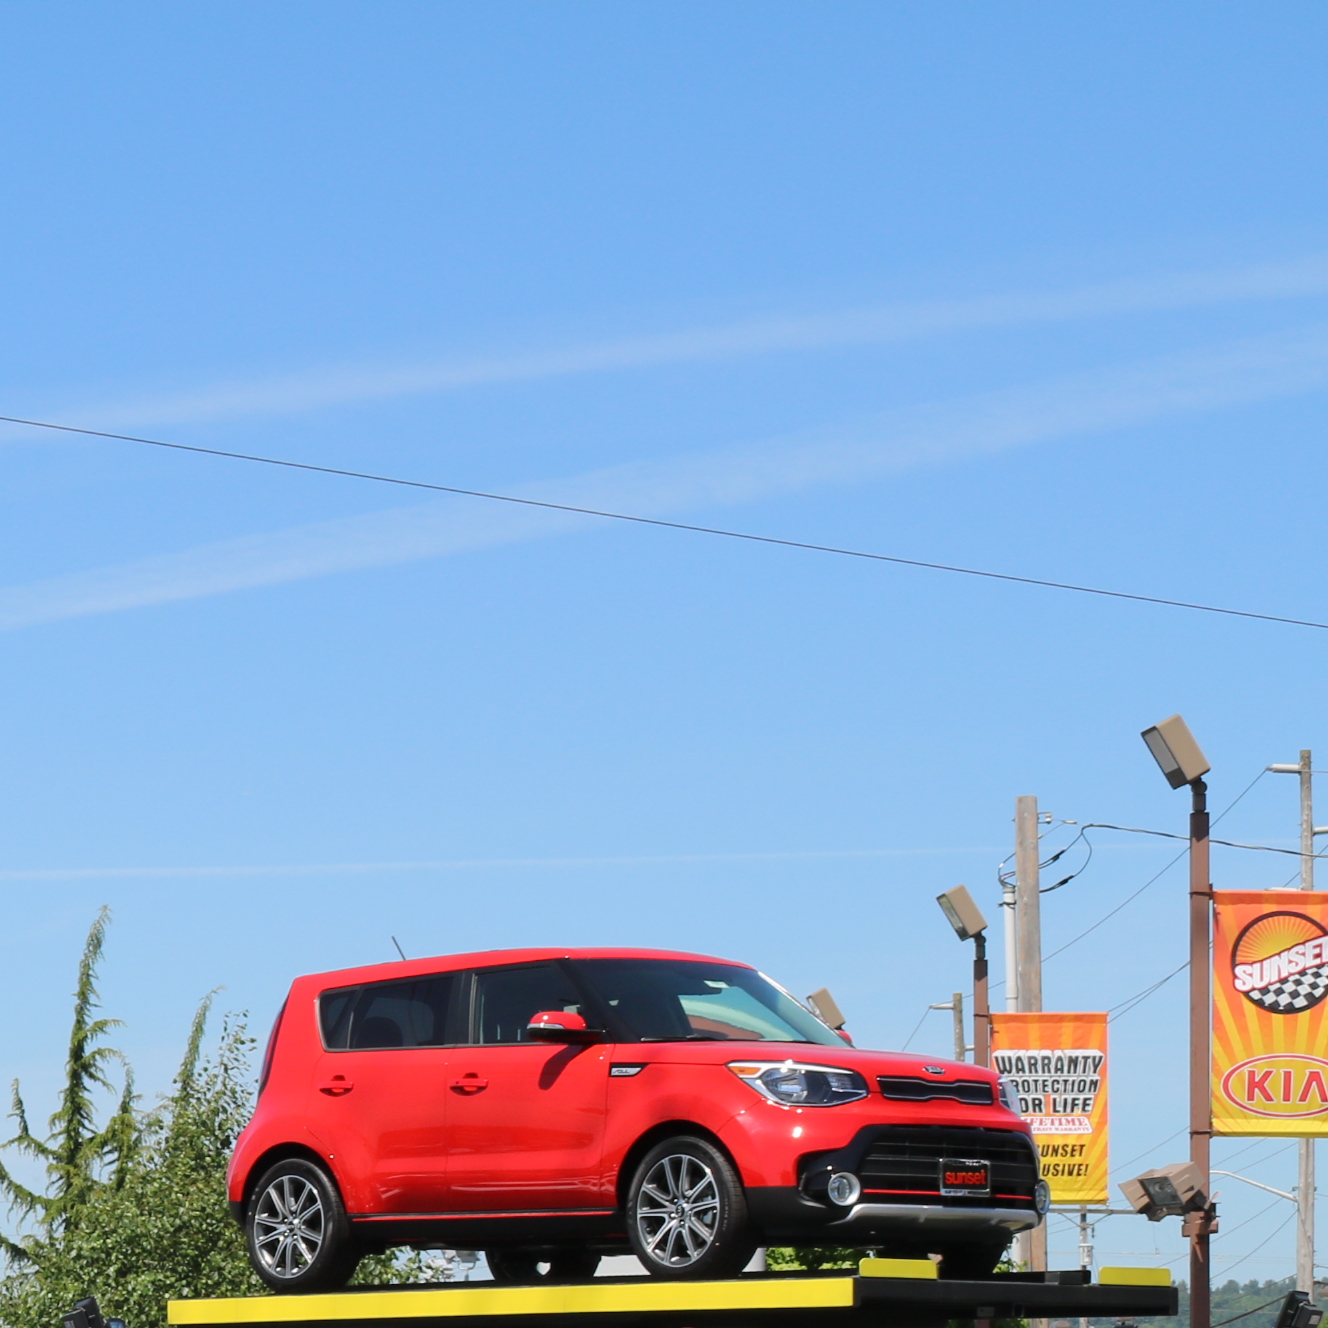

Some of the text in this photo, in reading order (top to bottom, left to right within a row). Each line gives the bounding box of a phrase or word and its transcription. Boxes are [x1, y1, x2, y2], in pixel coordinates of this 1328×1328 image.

[994, 1054, 1105, 1075] WARRANTY
[1010, 1079, 1099, 1094] ROTECTION
[1246, 1068, 1328, 1103] KIA
[1019, 1097, 1093, 1114] OR LIFE
[1025, 1117, 1088, 1127] FETIME
[1038, 1144, 1086, 1157] UNSET
[945, 1170, 986, 1184] sunset
